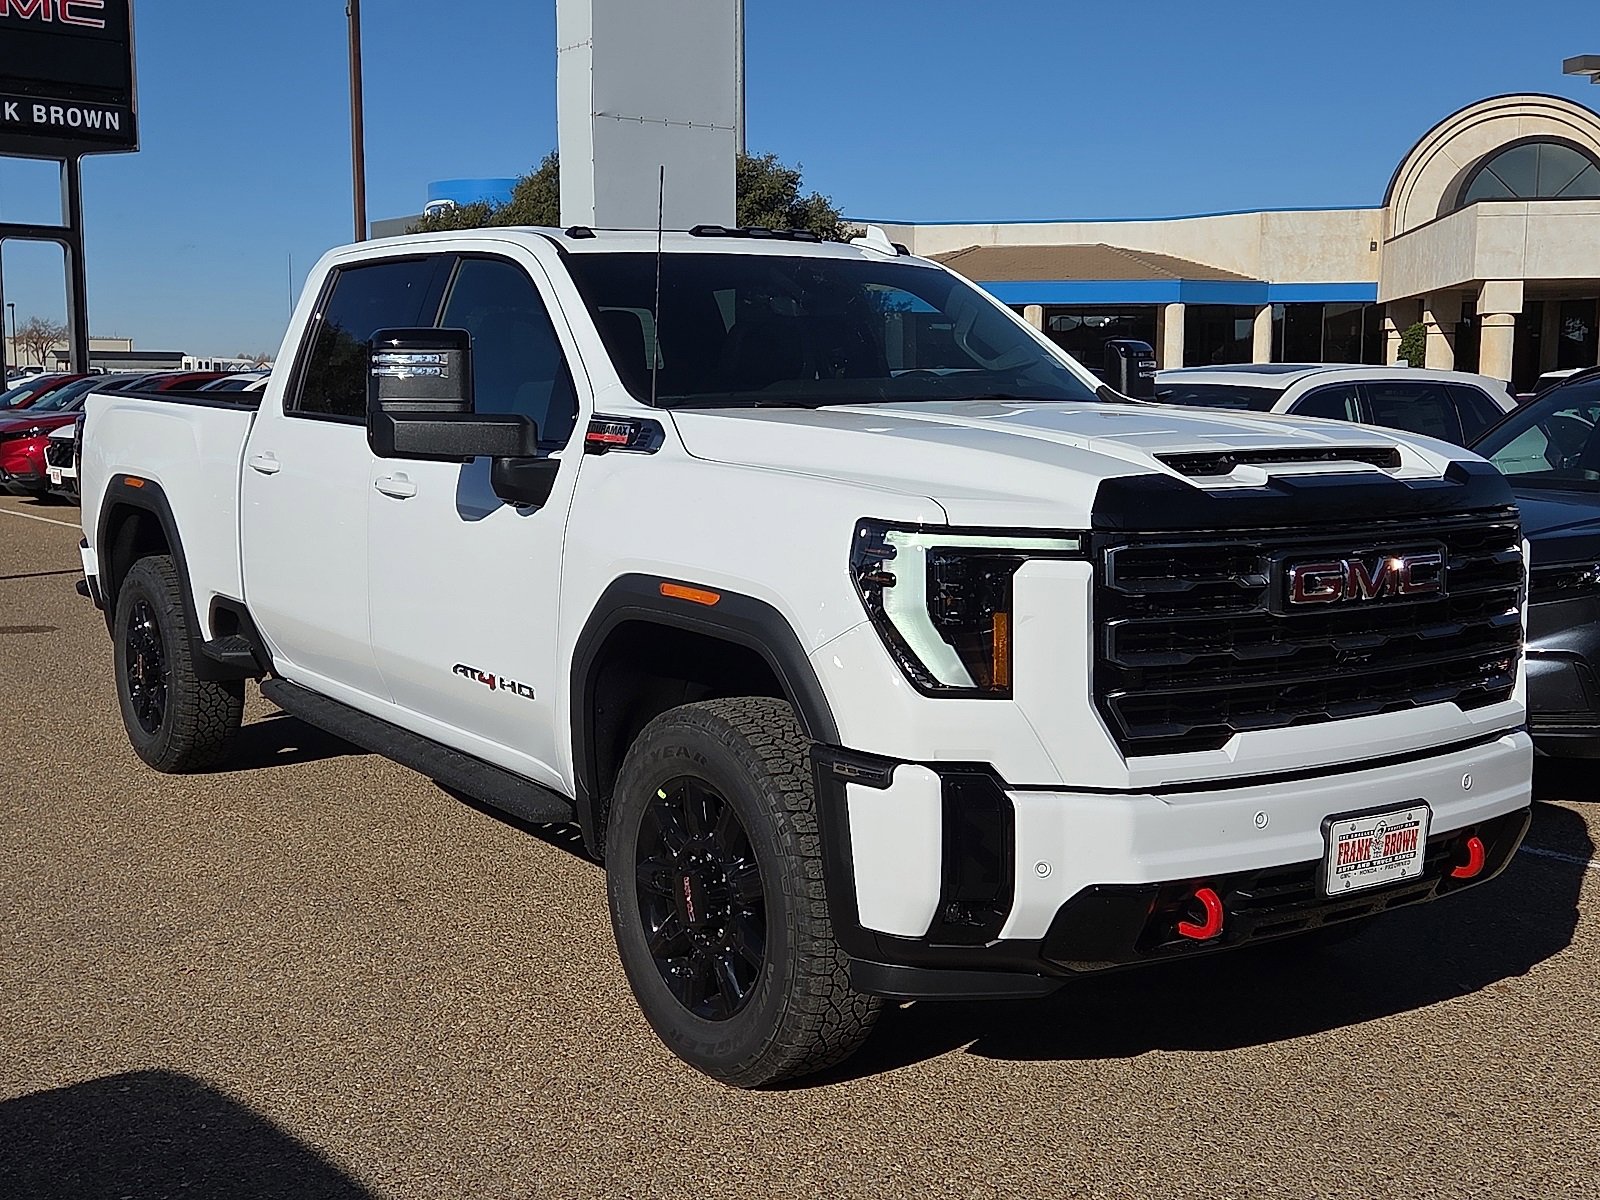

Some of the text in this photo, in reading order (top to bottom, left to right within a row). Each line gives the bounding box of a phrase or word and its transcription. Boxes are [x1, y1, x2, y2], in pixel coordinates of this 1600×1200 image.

[0, 0, 105, 28] MC
[32, 104, 119, 130] BROWN
[589, 423, 631, 436] DURAMAX
[1289, 552, 1442, 604] GMC
[1337, 829, 1419, 866] FRANK BROWN
[1338, 864, 1355, 873] AUTO
[1356, 861, 1371, 869] AND
[1372, 856, 1393, 866] TRUCK
